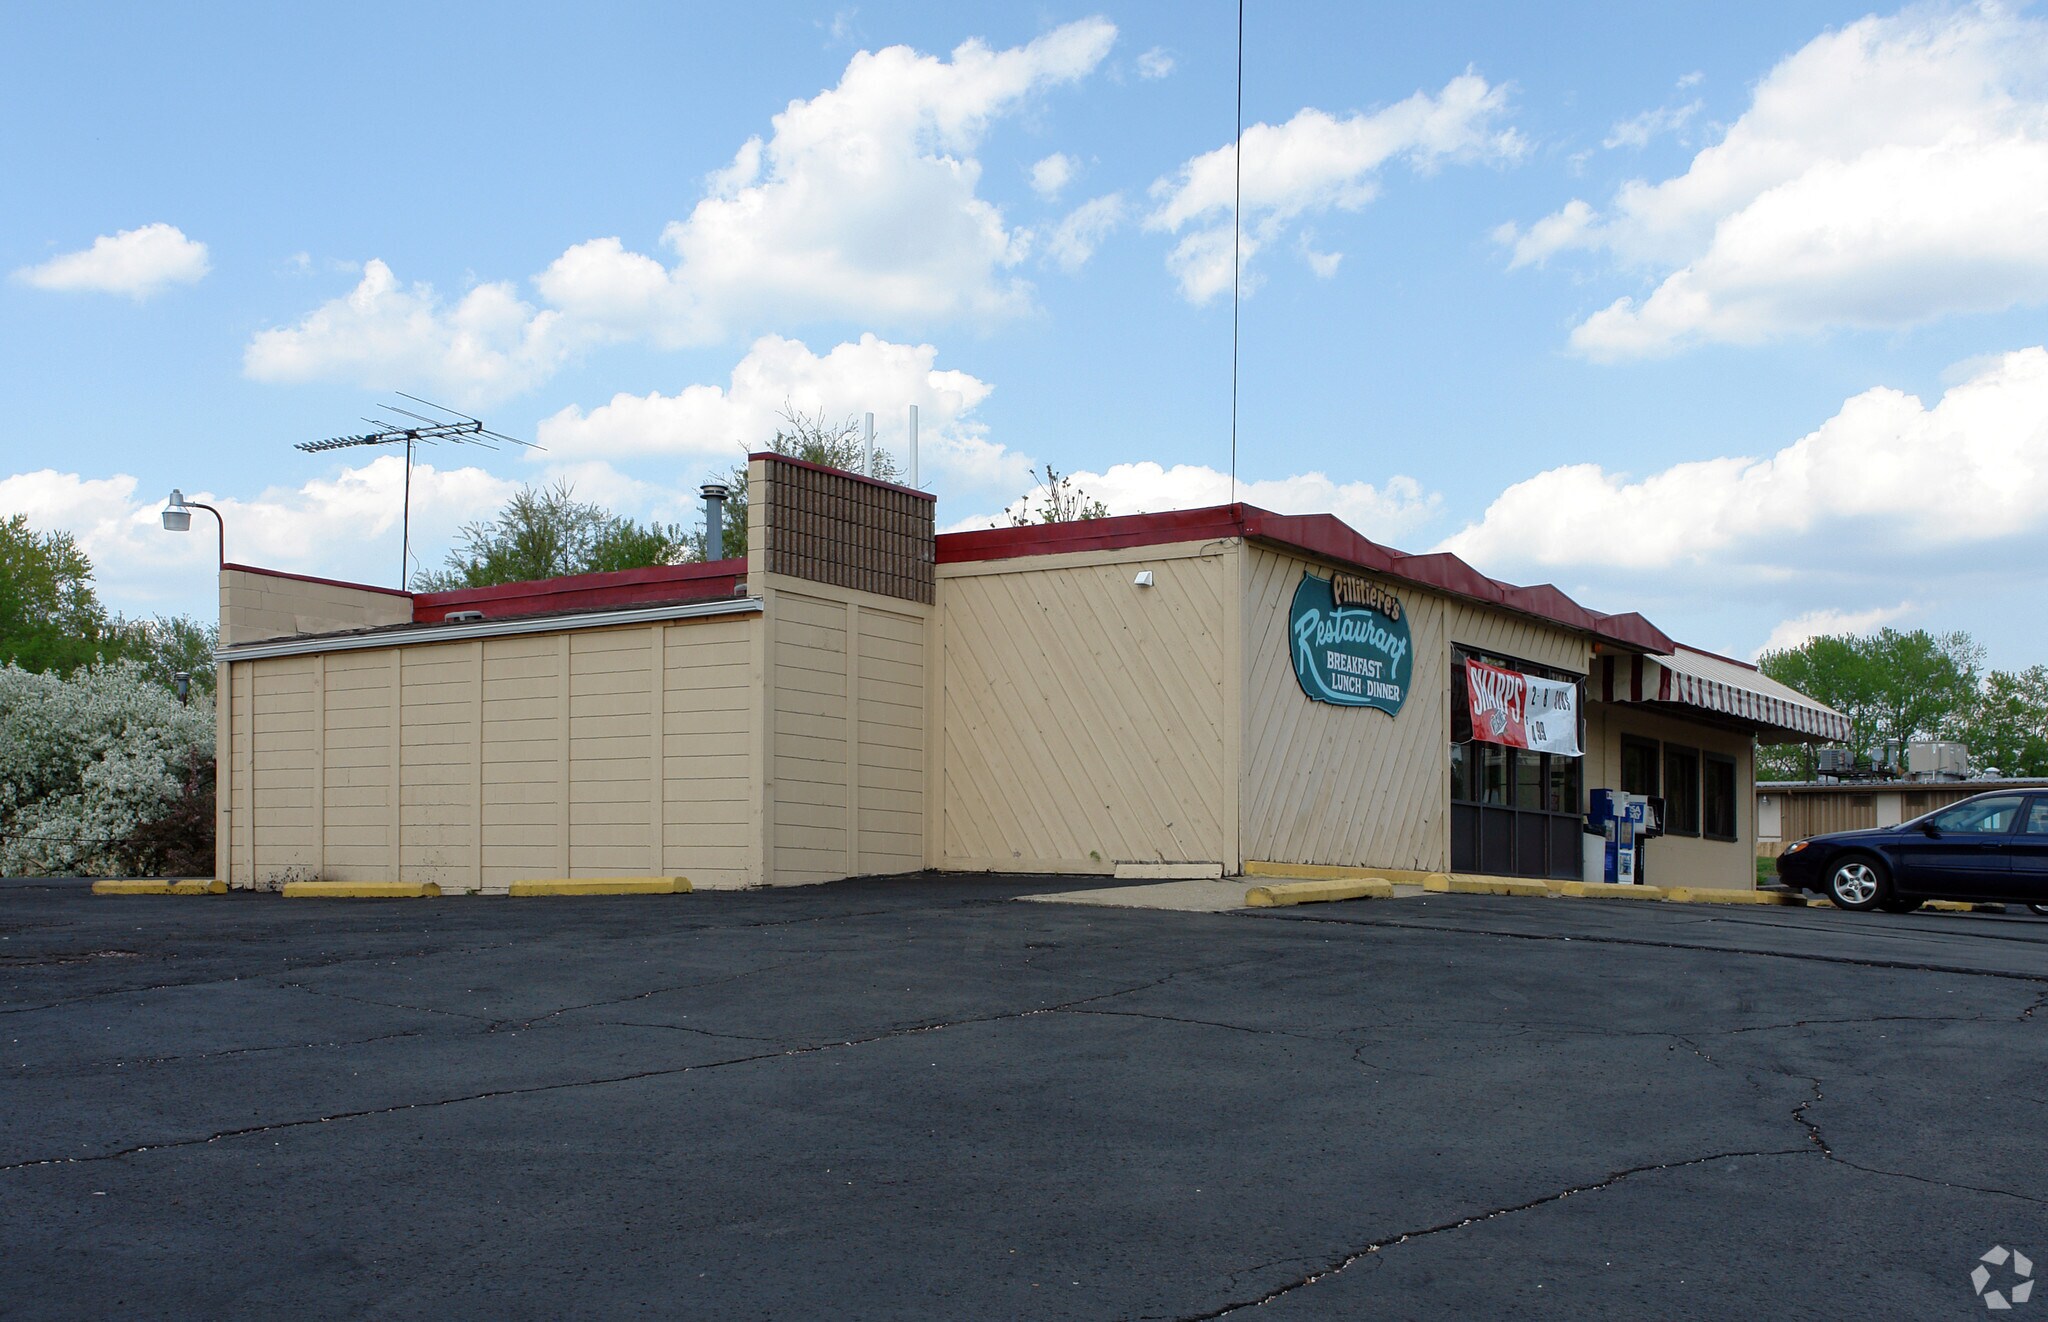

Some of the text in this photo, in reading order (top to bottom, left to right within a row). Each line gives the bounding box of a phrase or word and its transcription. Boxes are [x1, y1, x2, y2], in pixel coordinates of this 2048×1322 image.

[1334, 575, 1400, 620] Pillitiere's
[1295, 607, 1407, 701] Restaurant
[1327, 650, 1383, 679] BREAKFAST
[1331, 673, 1400, 702] LUNCH DINNER
